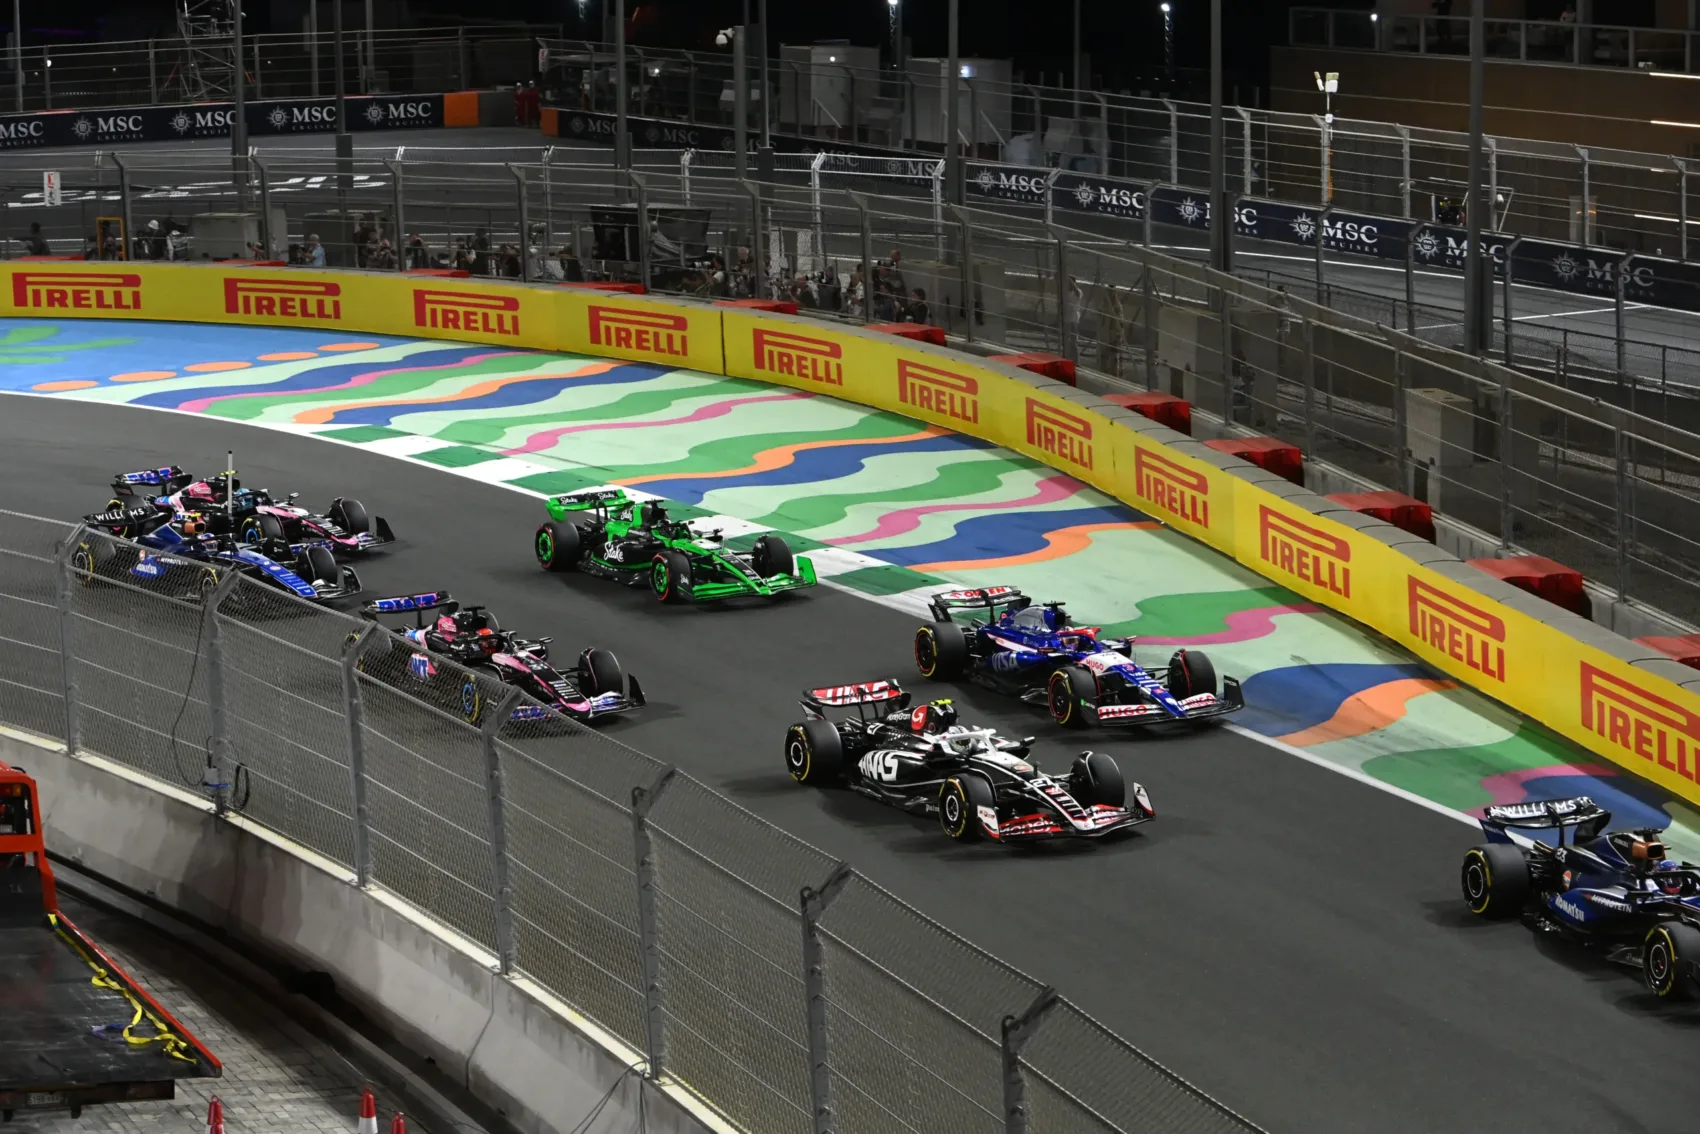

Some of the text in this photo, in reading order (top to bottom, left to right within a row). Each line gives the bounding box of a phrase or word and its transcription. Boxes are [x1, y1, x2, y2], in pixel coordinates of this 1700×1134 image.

[292, 106, 336, 123] MSC
[388, 102, 432, 119] MSC
[0, 121, 43, 139] MSC
[97, 115, 143, 133] MSC
[663, 128, 698, 145] MSC
[907, 160, 937, 178] MS
[999, 172, 1045, 194] MSC
[1098, 206, 1142, 217] CRUISE
[1322, 219, 1378, 244] MSC
[1322, 240, 1378, 253] CRUISES
[12, 272, 142, 310] PIRELLI
[224, 278, 341, 320] PIRELLI
[413, 289, 519, 336] PIRELLI
[588, 305, 688, 356] PIRELLI
[753, 328, 843, 386] PIRELLI
[897, 358, 978, 424] PIRELLI
[1025, 396, 1093, 471] PIRELLI
[1135, 445, 1208, 529] PIRELLI
[95, 508, 145, 521] WILLIMS
[604, 541, 624, 562] Stake
[1259, 504, 1351, 600] PIRELLI
[1407, 573, 1506, 683] PIRELLI
[1086, 660, 1104, 671] HUGO
[1098, 705, 1148, 719] HUGO
[858, 750, 899, 782] HAAS
[1503, 800, 1577, 817] WILLIMS
[1555, 892, 1585, 922] KOMATSU
[1591, 894, 1632, 913] MYPROTEIN
